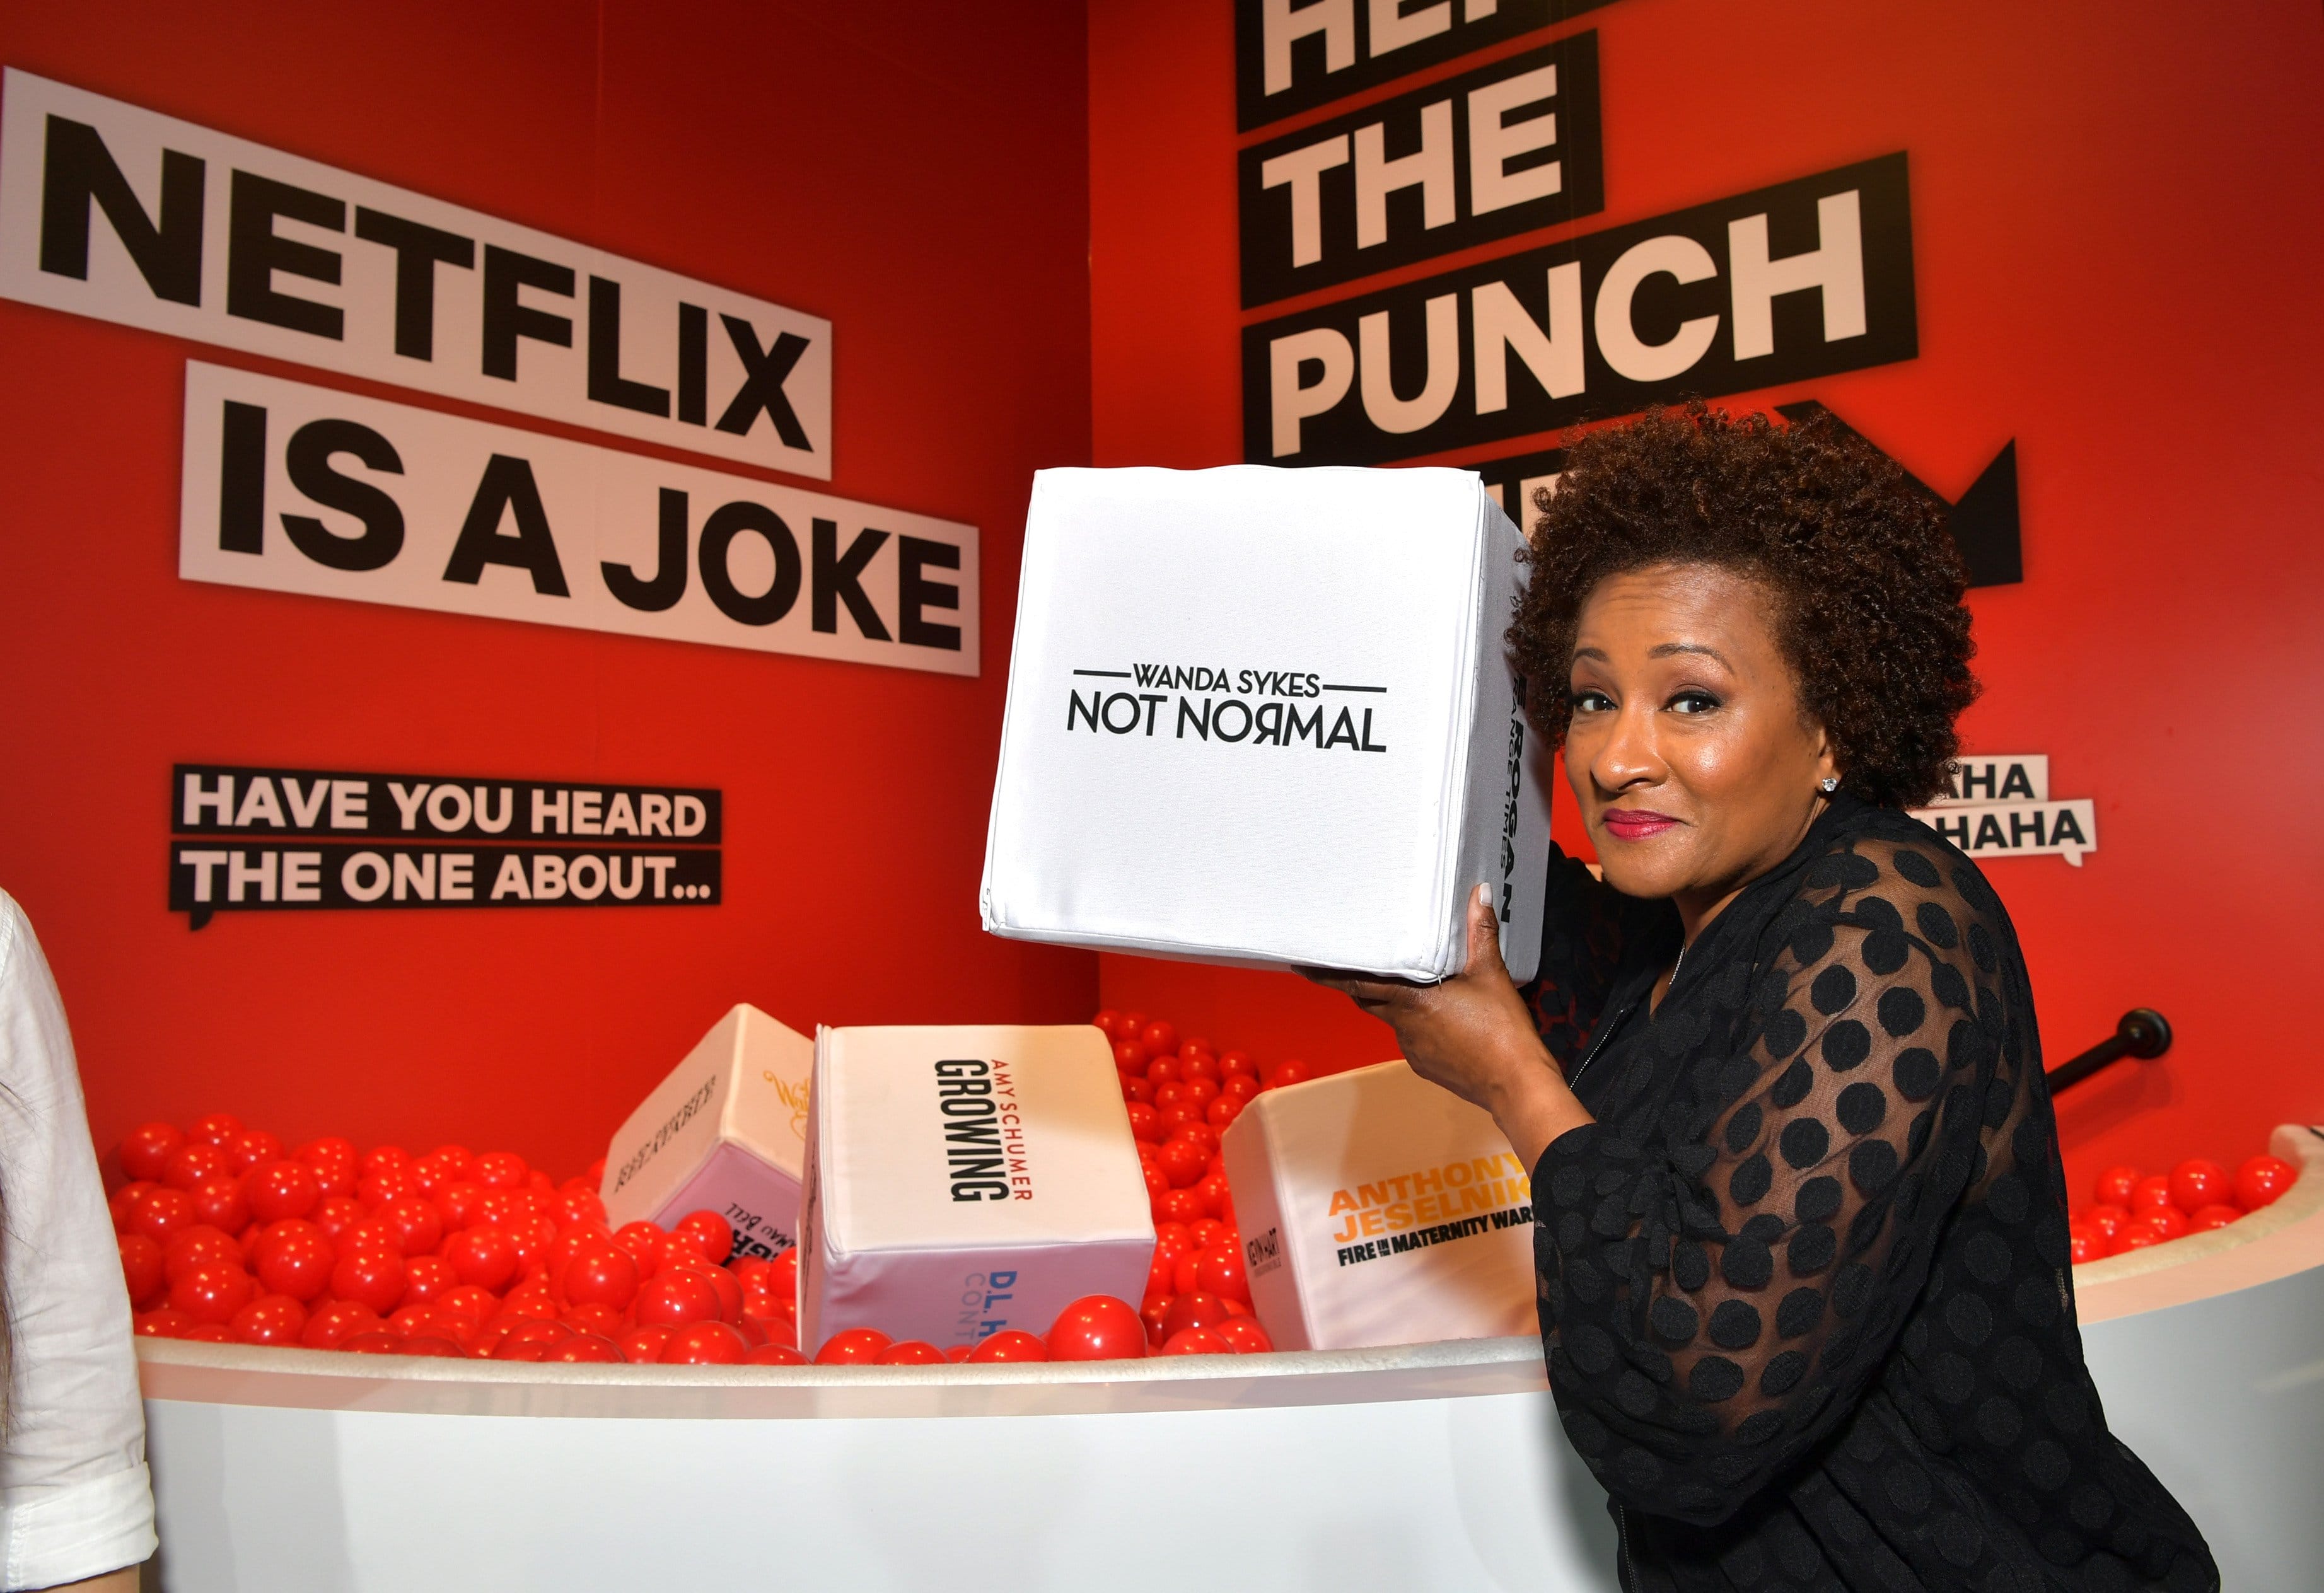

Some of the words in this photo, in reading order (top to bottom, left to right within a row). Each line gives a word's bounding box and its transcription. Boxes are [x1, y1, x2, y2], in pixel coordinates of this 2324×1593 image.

[1262, 64, 1561, 268] THE
[39, 112, 814, 453] NETFLIX
[1270, 189, 1866, 458] PUNCH
[219, 399, 405, 571] IS
[443, 453, 571, 598] A
[600, 487, 962, 651] JOKE
[1067, 689, 1168, 736] NOT
[1133, 663, 1231, 693] WANDA
[1237, 670, 1320, 698] SYKES
[1506, 676, 1518, 777] RANGE
[182, 773, 369, 830] HAVE
[387, 782, 514, 833] YOU
[530, 789, 707, 837] HEARD
[1948, 763, 2035, 799] HA
[1500, 787, 1511, 869] TIMES
[1501, 720, 1524, 923] ROGAN
[1934, 809, 2087, 850] HAHA
[180, 850, 322, 902] THE
[341, 851, 474, 901] ONE
[490, 854, 711, 900] ABOUT...
[991, 1059, 1016, 1098] AMY
[934, 1060, 1009, 1202] GROWING
[1000, 1103, 1033, 1200] SCHUMER
[1328, 1152, 1525, 1217] ANTHONY
[1337, 1241, 1377, 1266] FIRE
[1390, 1215, 1490, 1254] MATERNITY
[1489, 1205, 1534, 1229] WAR
[954, 1272, 985, 1340] CONT
[983, 1271, 1017, 1314] D.L.
